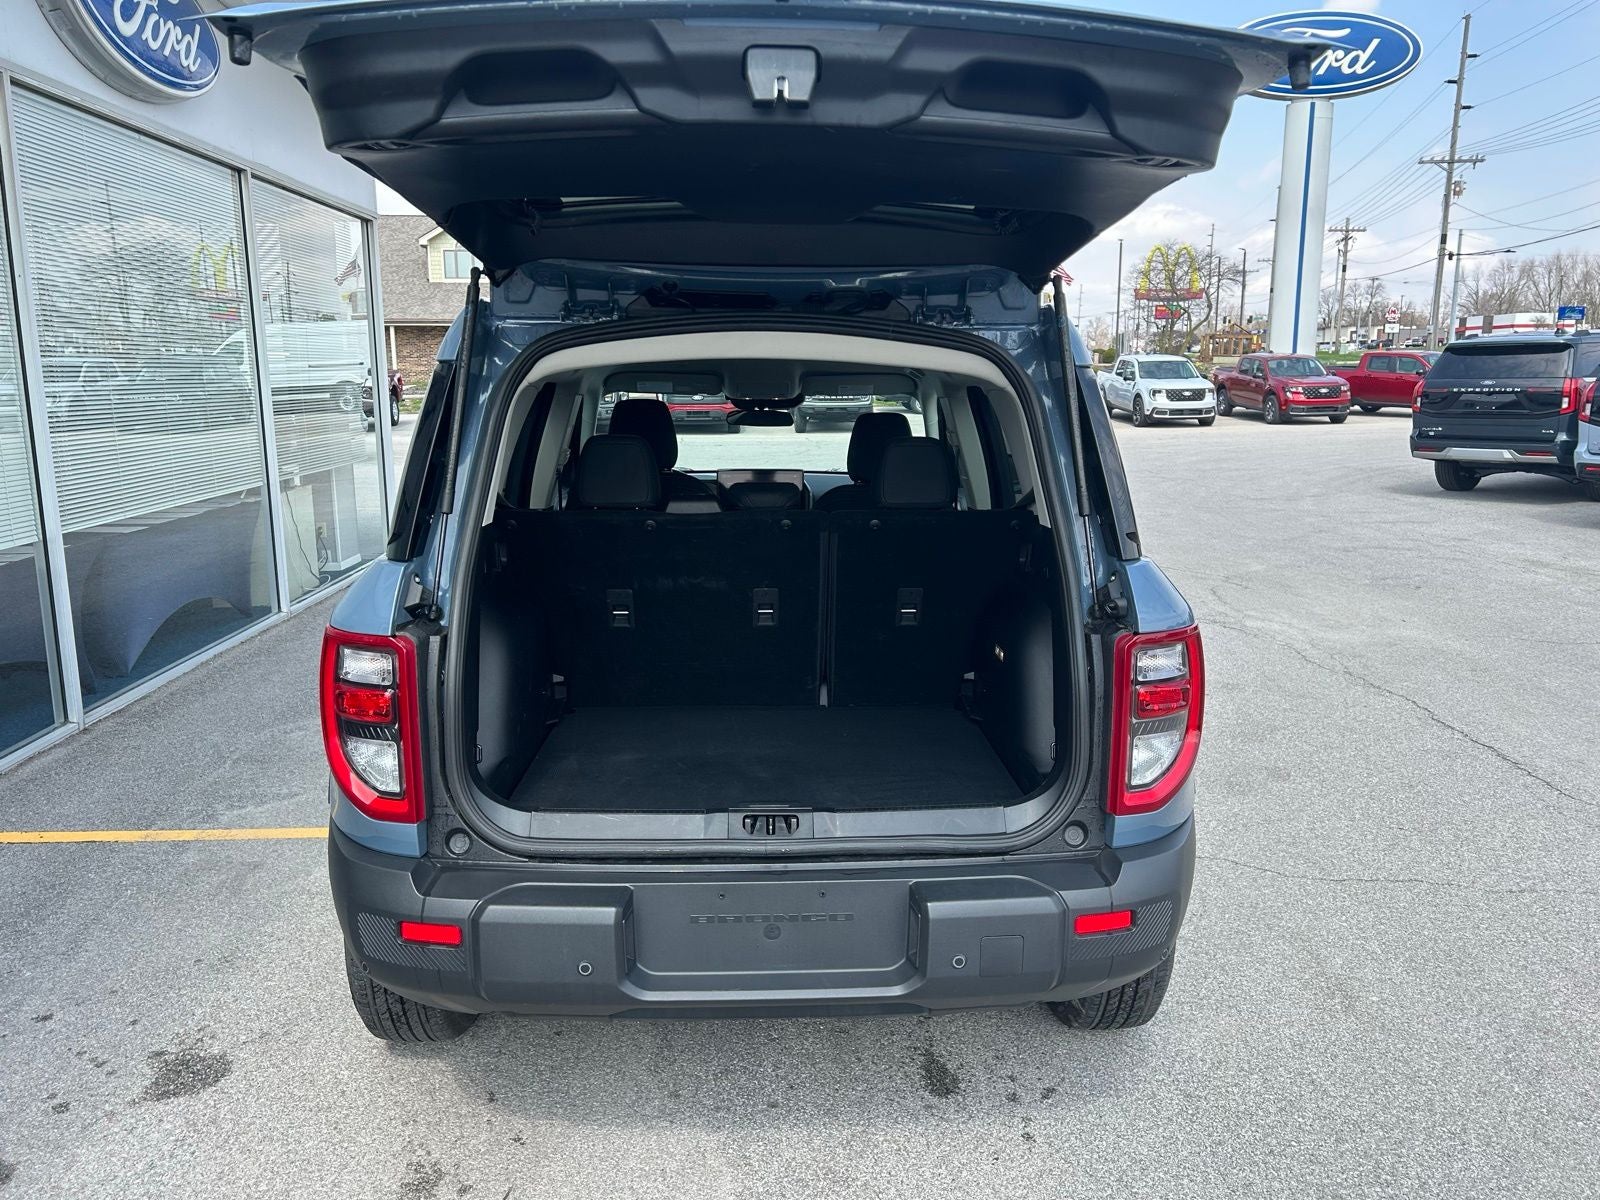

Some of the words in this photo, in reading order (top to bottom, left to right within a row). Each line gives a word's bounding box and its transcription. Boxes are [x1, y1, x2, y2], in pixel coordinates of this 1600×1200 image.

[112, 0, 201, 73] Ford
[1281, 26, 1382, 76] Frd
[689, 912, 854, 924] BRONCO
